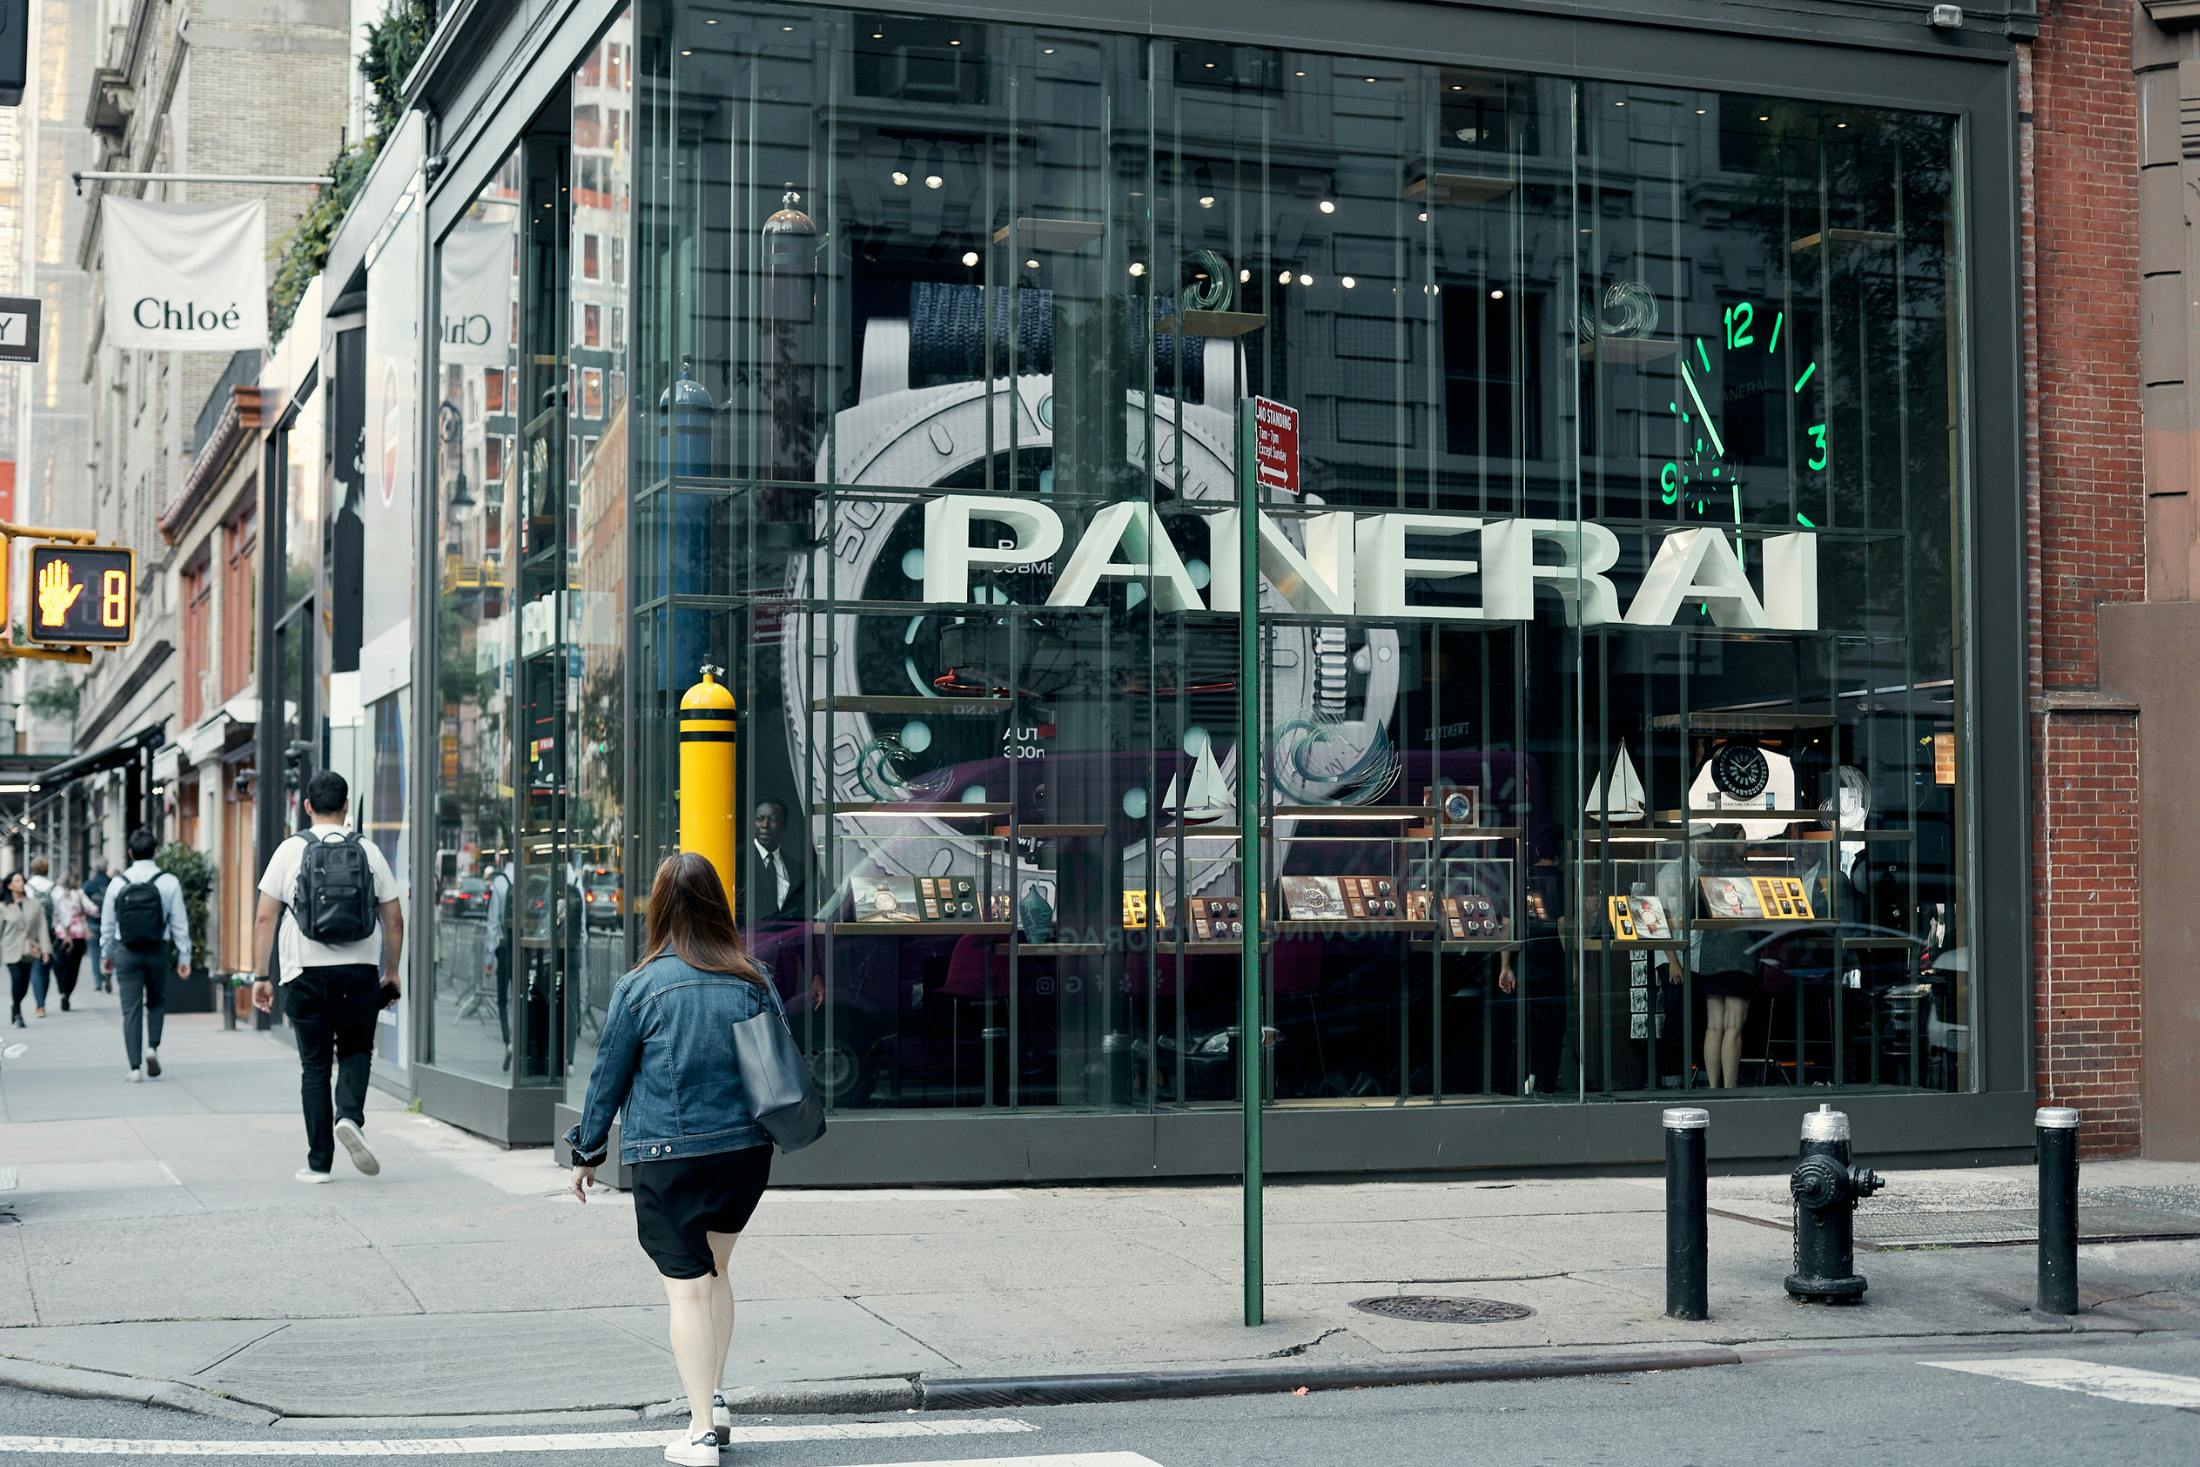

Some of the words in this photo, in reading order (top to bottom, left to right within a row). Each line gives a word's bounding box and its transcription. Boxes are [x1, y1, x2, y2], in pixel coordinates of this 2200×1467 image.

[133, 297, 241, 331] Chloé
[1724, 302, 1754, 350] 12
[1258, 405, 1266, 423] NO
[1267, 408, 1292, 431] STANDING
[1258, 441, 1272, 460] Except
[1272, 446, 1287, 464] Sunday
[1808, 423, 1827, 472] 3
[1660, 462, 1678, 506] 9
[923, 494, 1818, 631] PANERAI
[102, 569, 127, 629] 8
